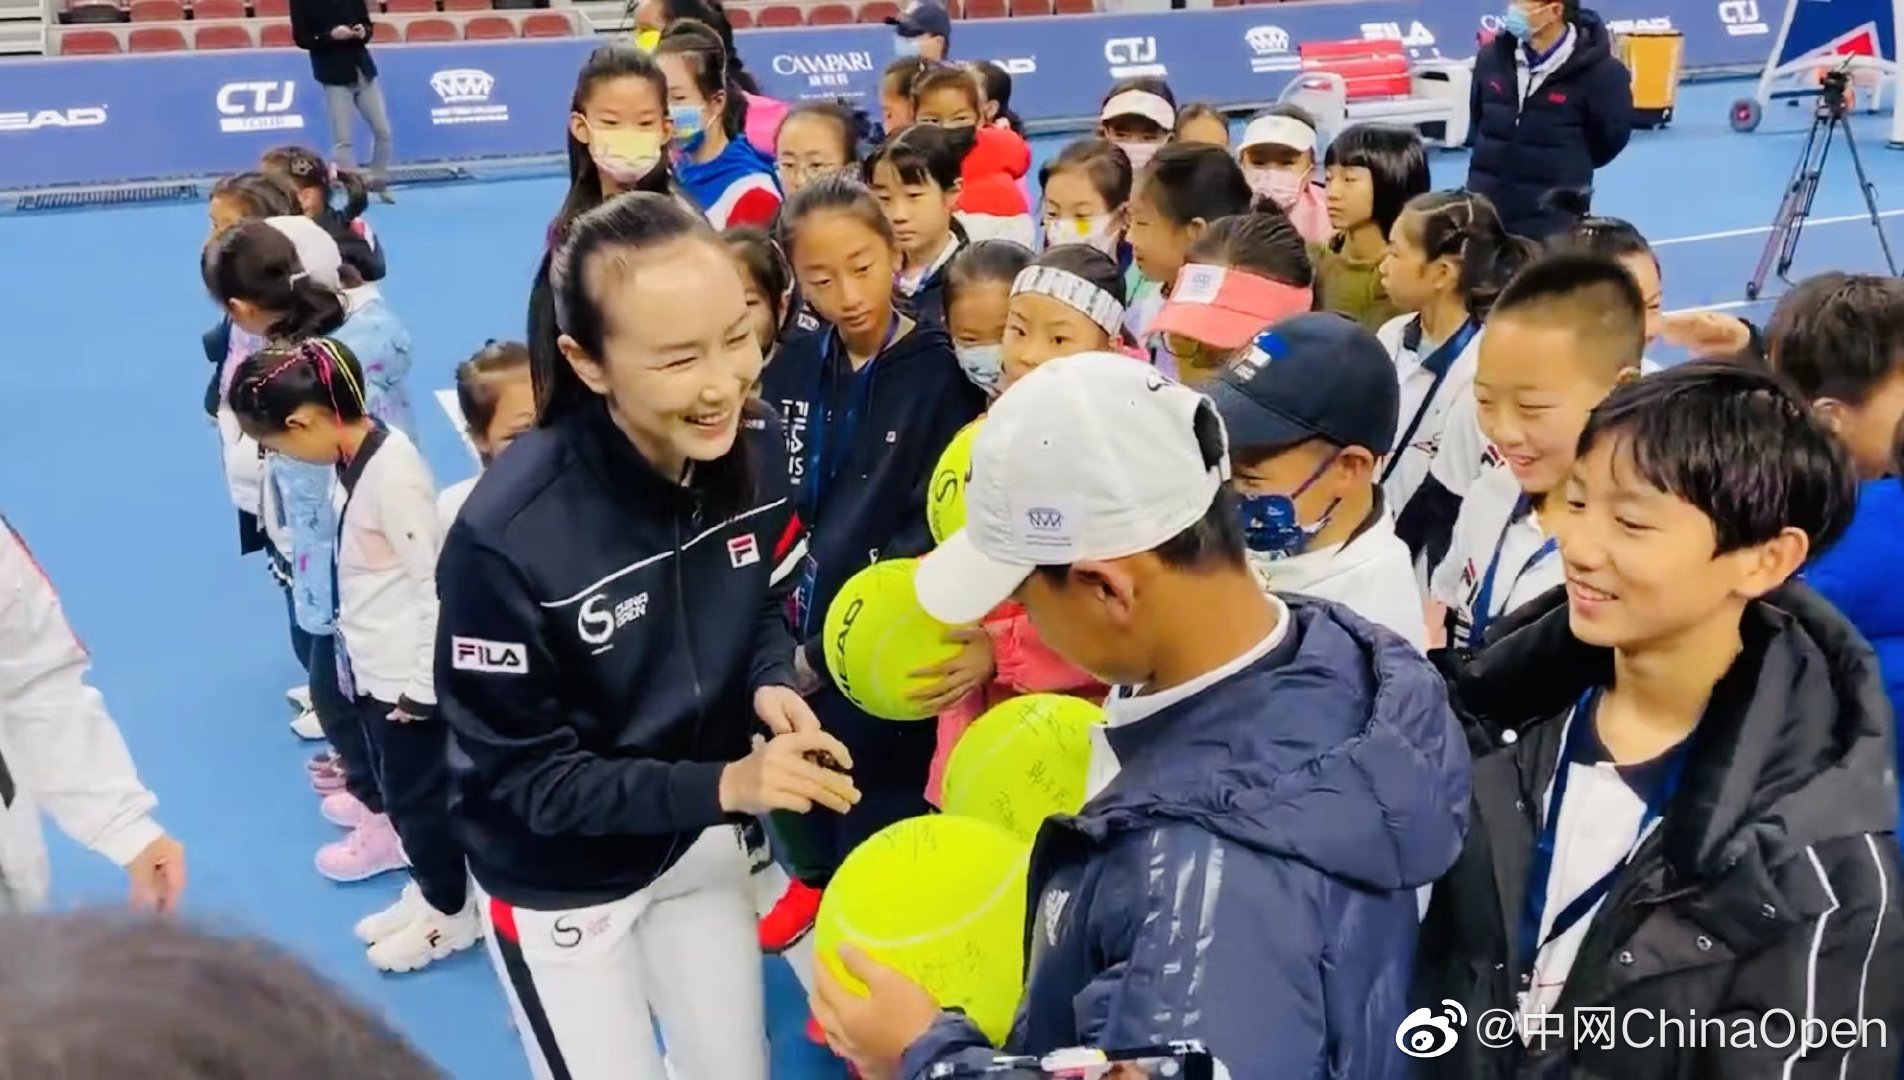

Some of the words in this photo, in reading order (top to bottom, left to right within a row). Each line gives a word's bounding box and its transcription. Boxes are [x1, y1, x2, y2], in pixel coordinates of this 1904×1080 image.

[1105, 37, 1157, 64] CTJ
[216, 81, 295, 114] CTJ
[458, 643, 521, 667] FILA
